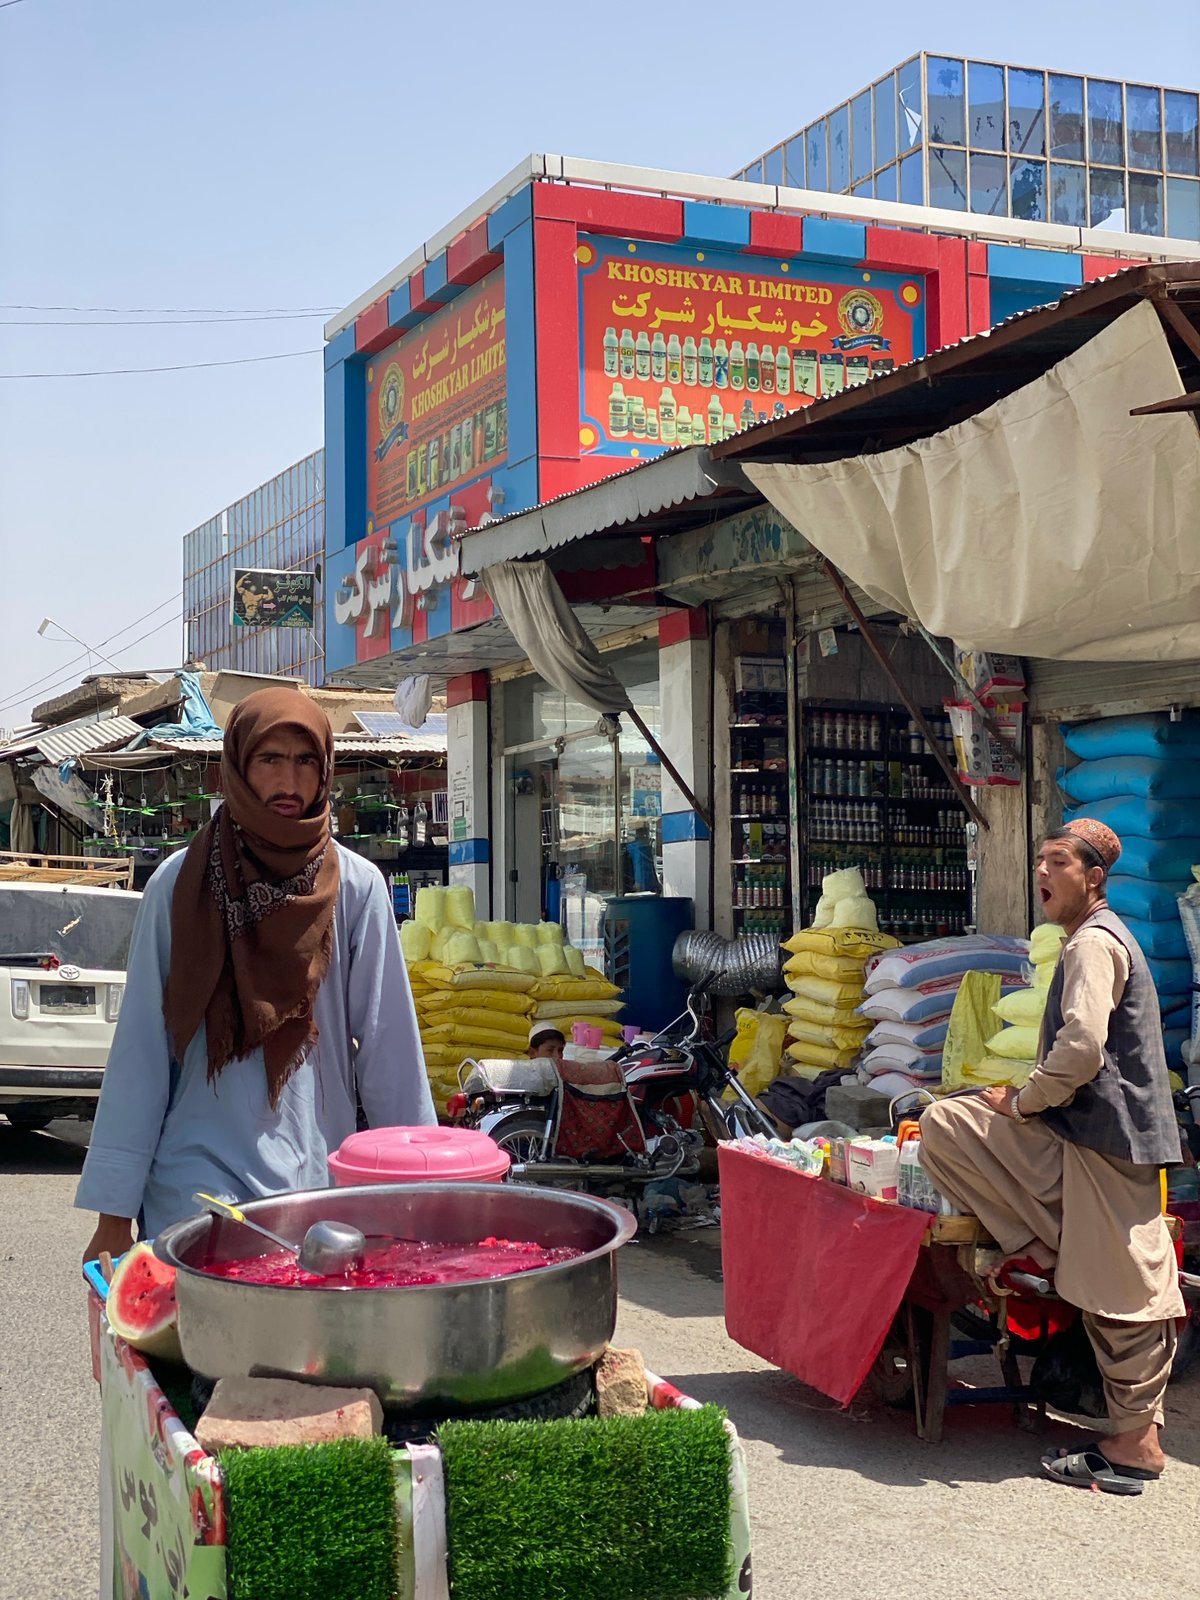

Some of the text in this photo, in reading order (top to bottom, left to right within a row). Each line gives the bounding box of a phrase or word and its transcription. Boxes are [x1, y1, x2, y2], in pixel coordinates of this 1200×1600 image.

[607, 261, 833, 305] KHOSHKYAR LIMITED
[411, 363, 470, 421] KHOSHKYAR
